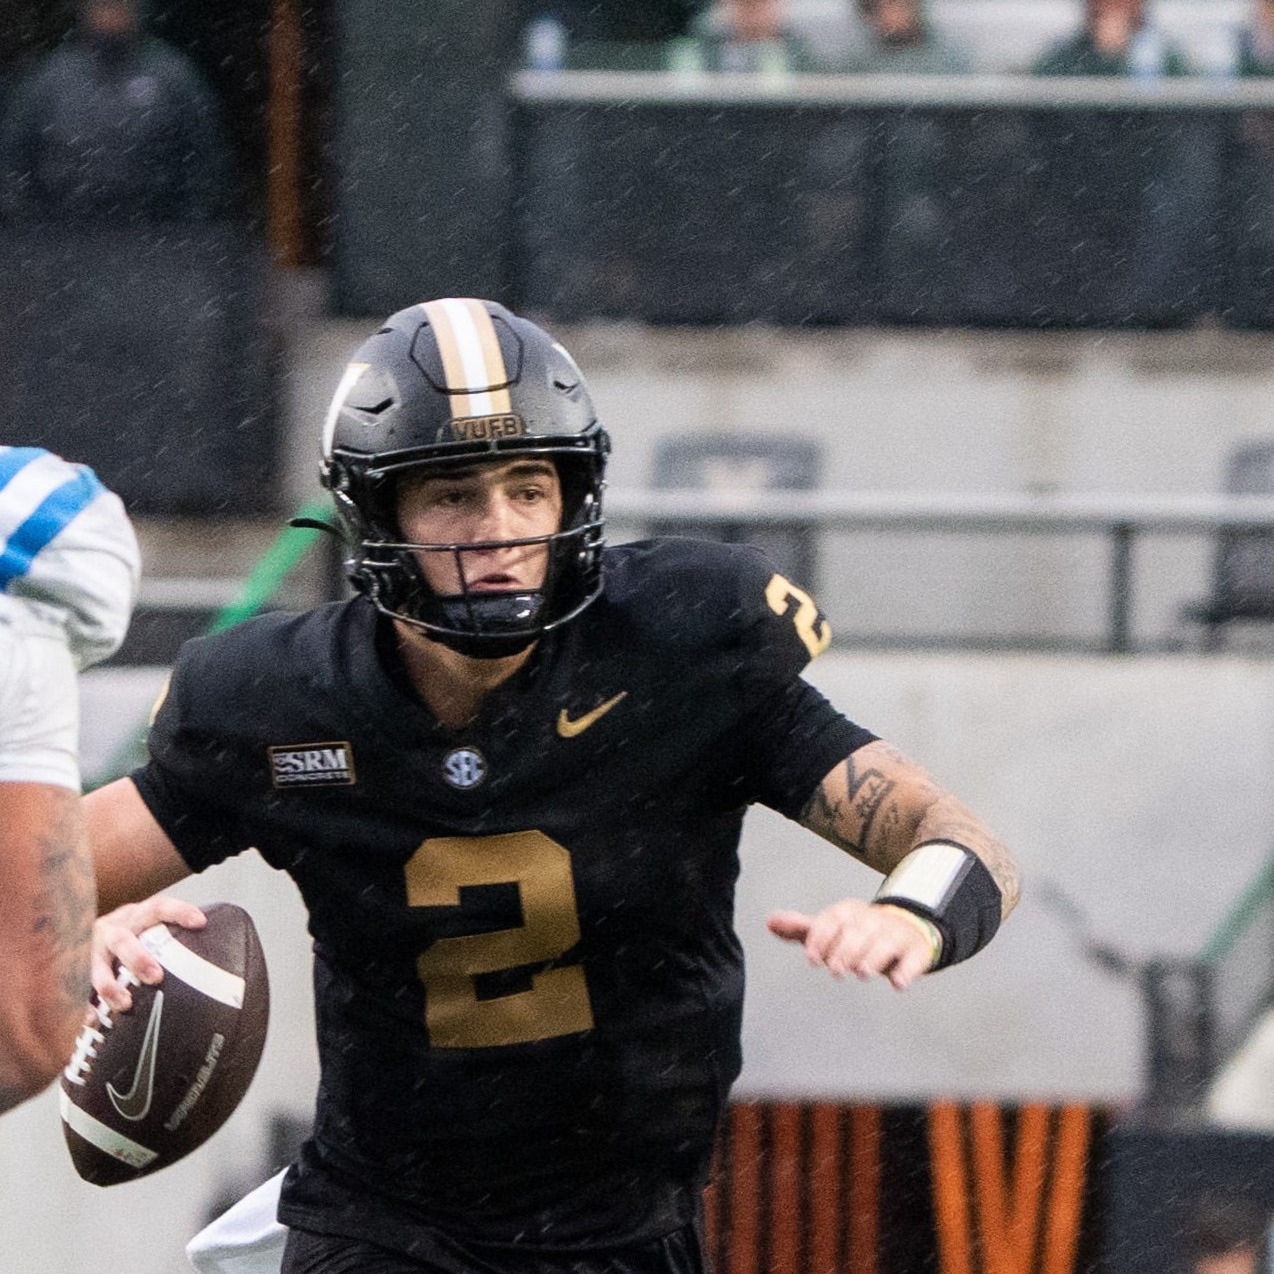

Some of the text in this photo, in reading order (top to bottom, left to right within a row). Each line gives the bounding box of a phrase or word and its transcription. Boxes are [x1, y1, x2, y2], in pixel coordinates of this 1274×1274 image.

[452, 417, 519, 440] VUFB
[765, 573, 832, 660] 2
[405, 829, 594, 1048] 2
